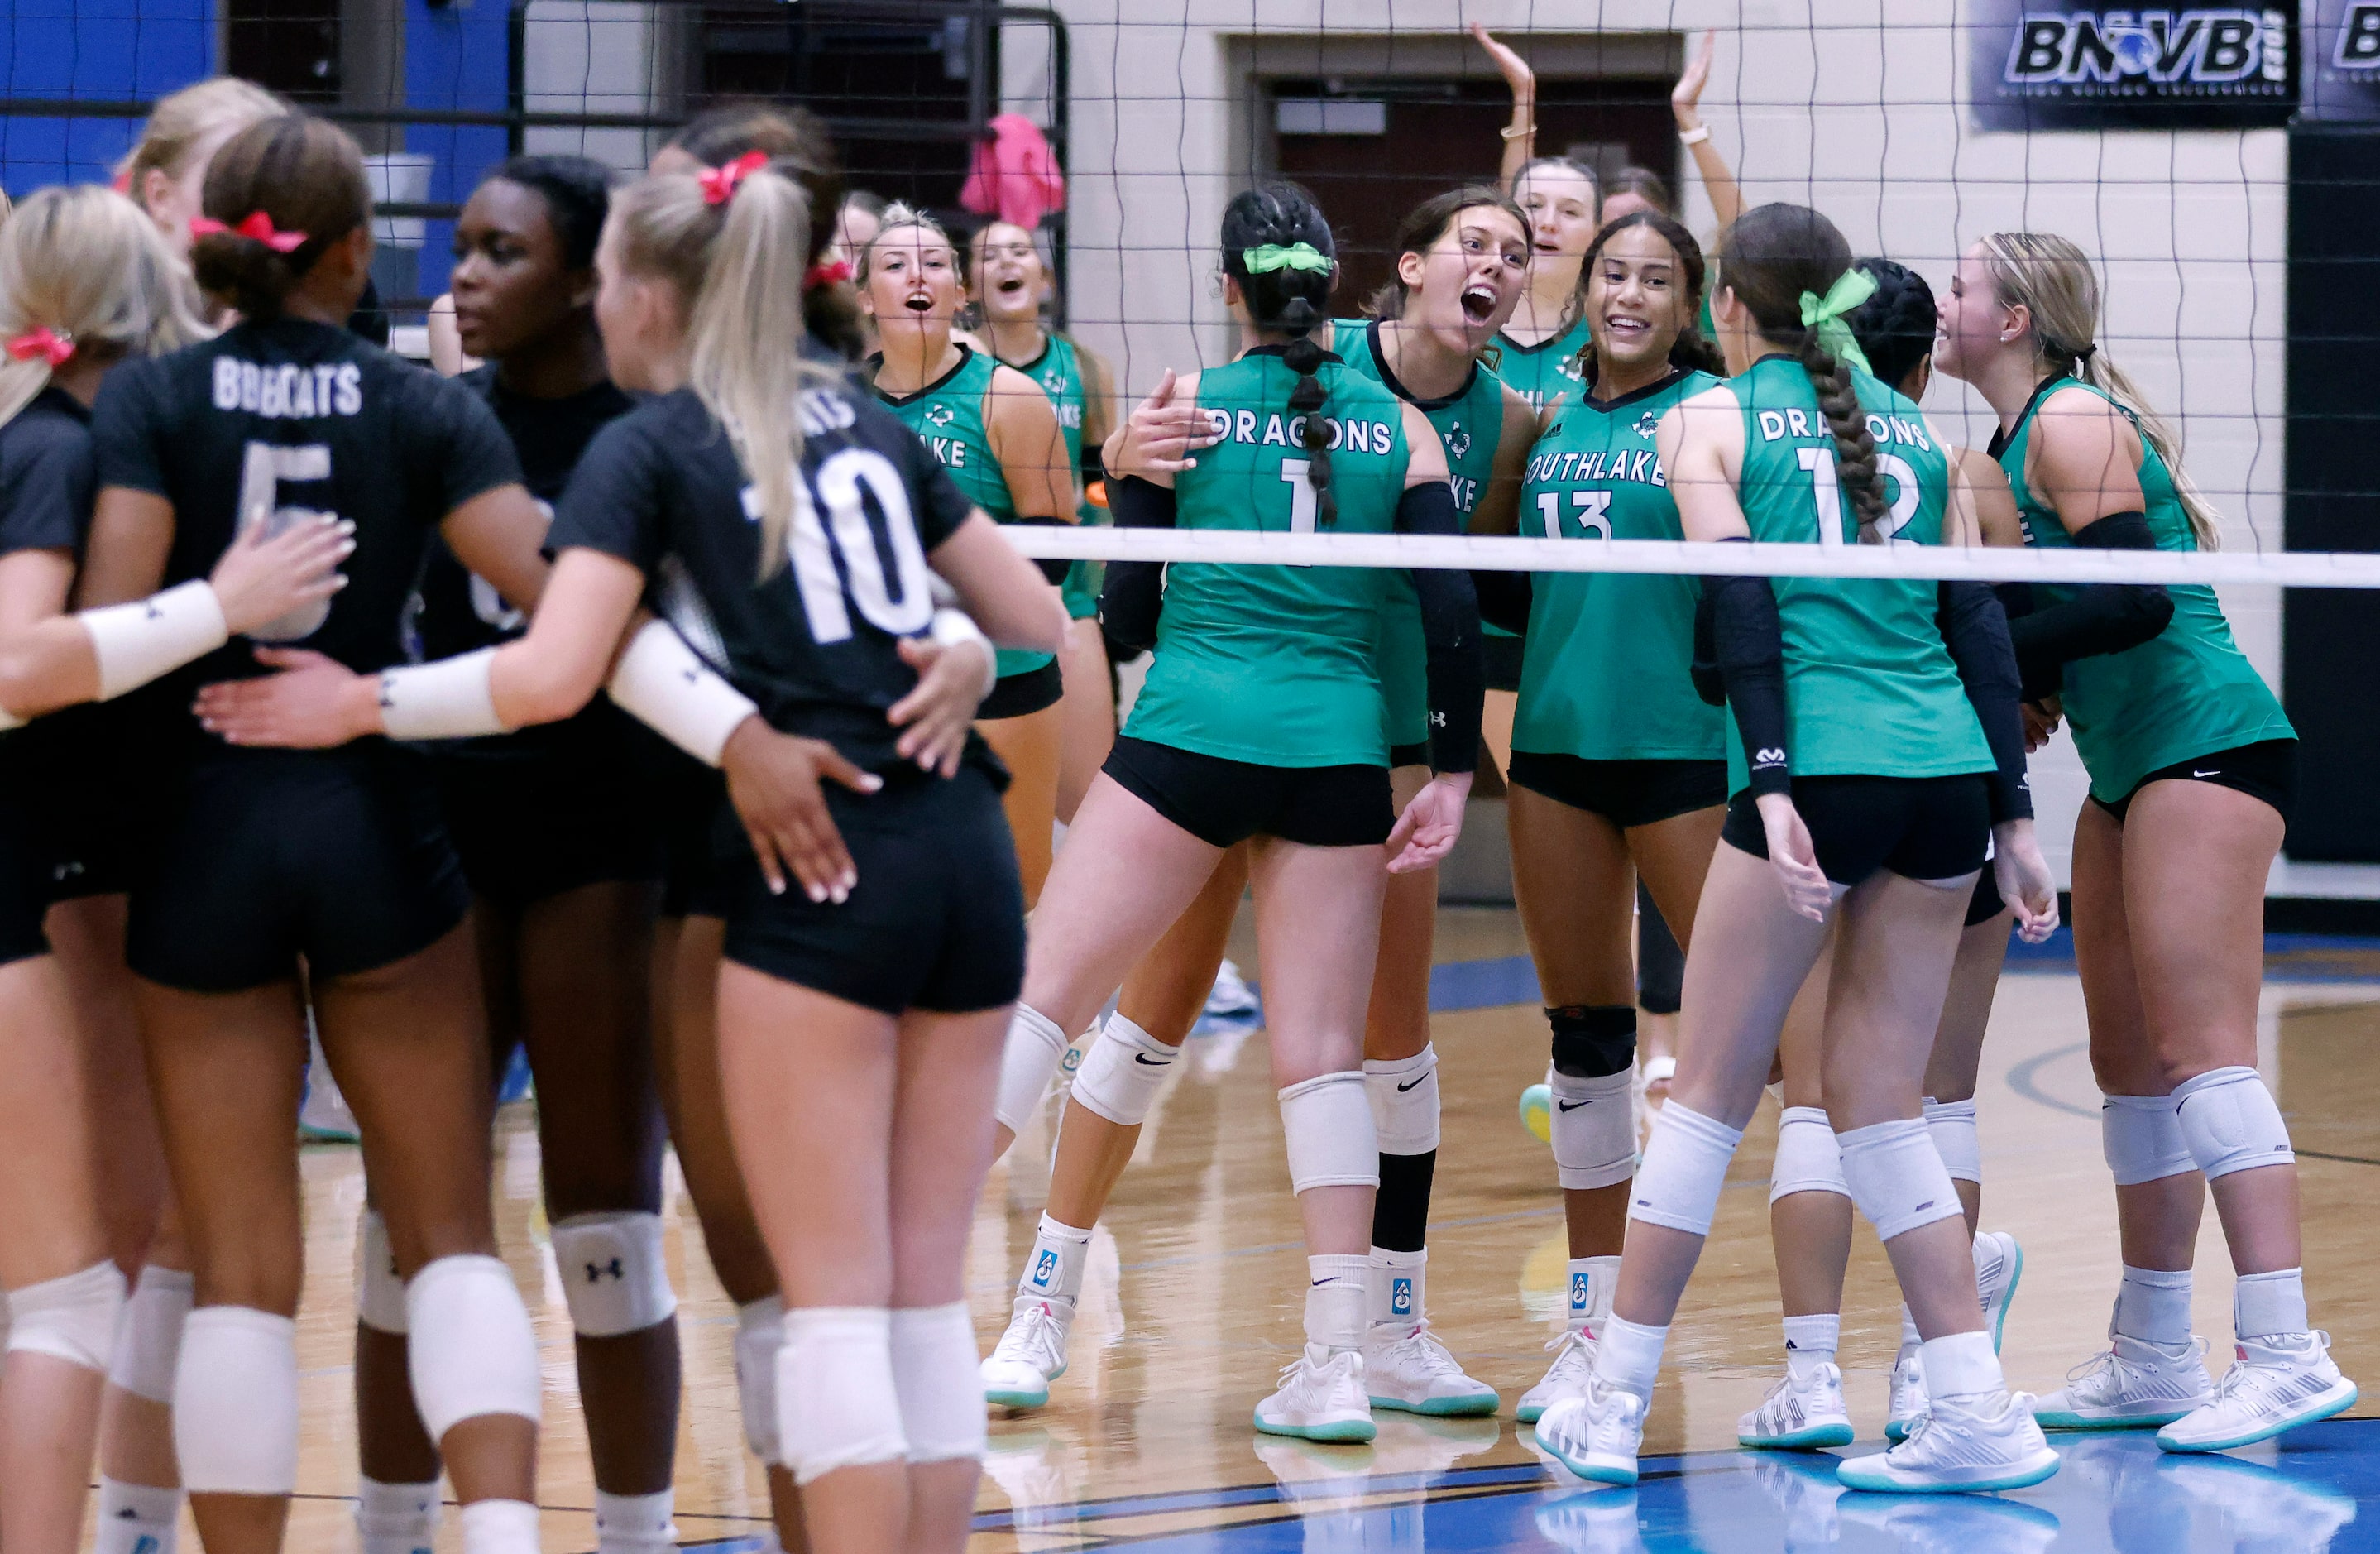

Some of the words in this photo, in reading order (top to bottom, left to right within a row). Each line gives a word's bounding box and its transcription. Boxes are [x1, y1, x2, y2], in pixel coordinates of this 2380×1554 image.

[213, 356, 363, 418] BOBCATS
[1757, 407, 1931, 453] DRAONS
[1794, 447, 1921, 546] 12
[740, 448, 934, 645] 10
